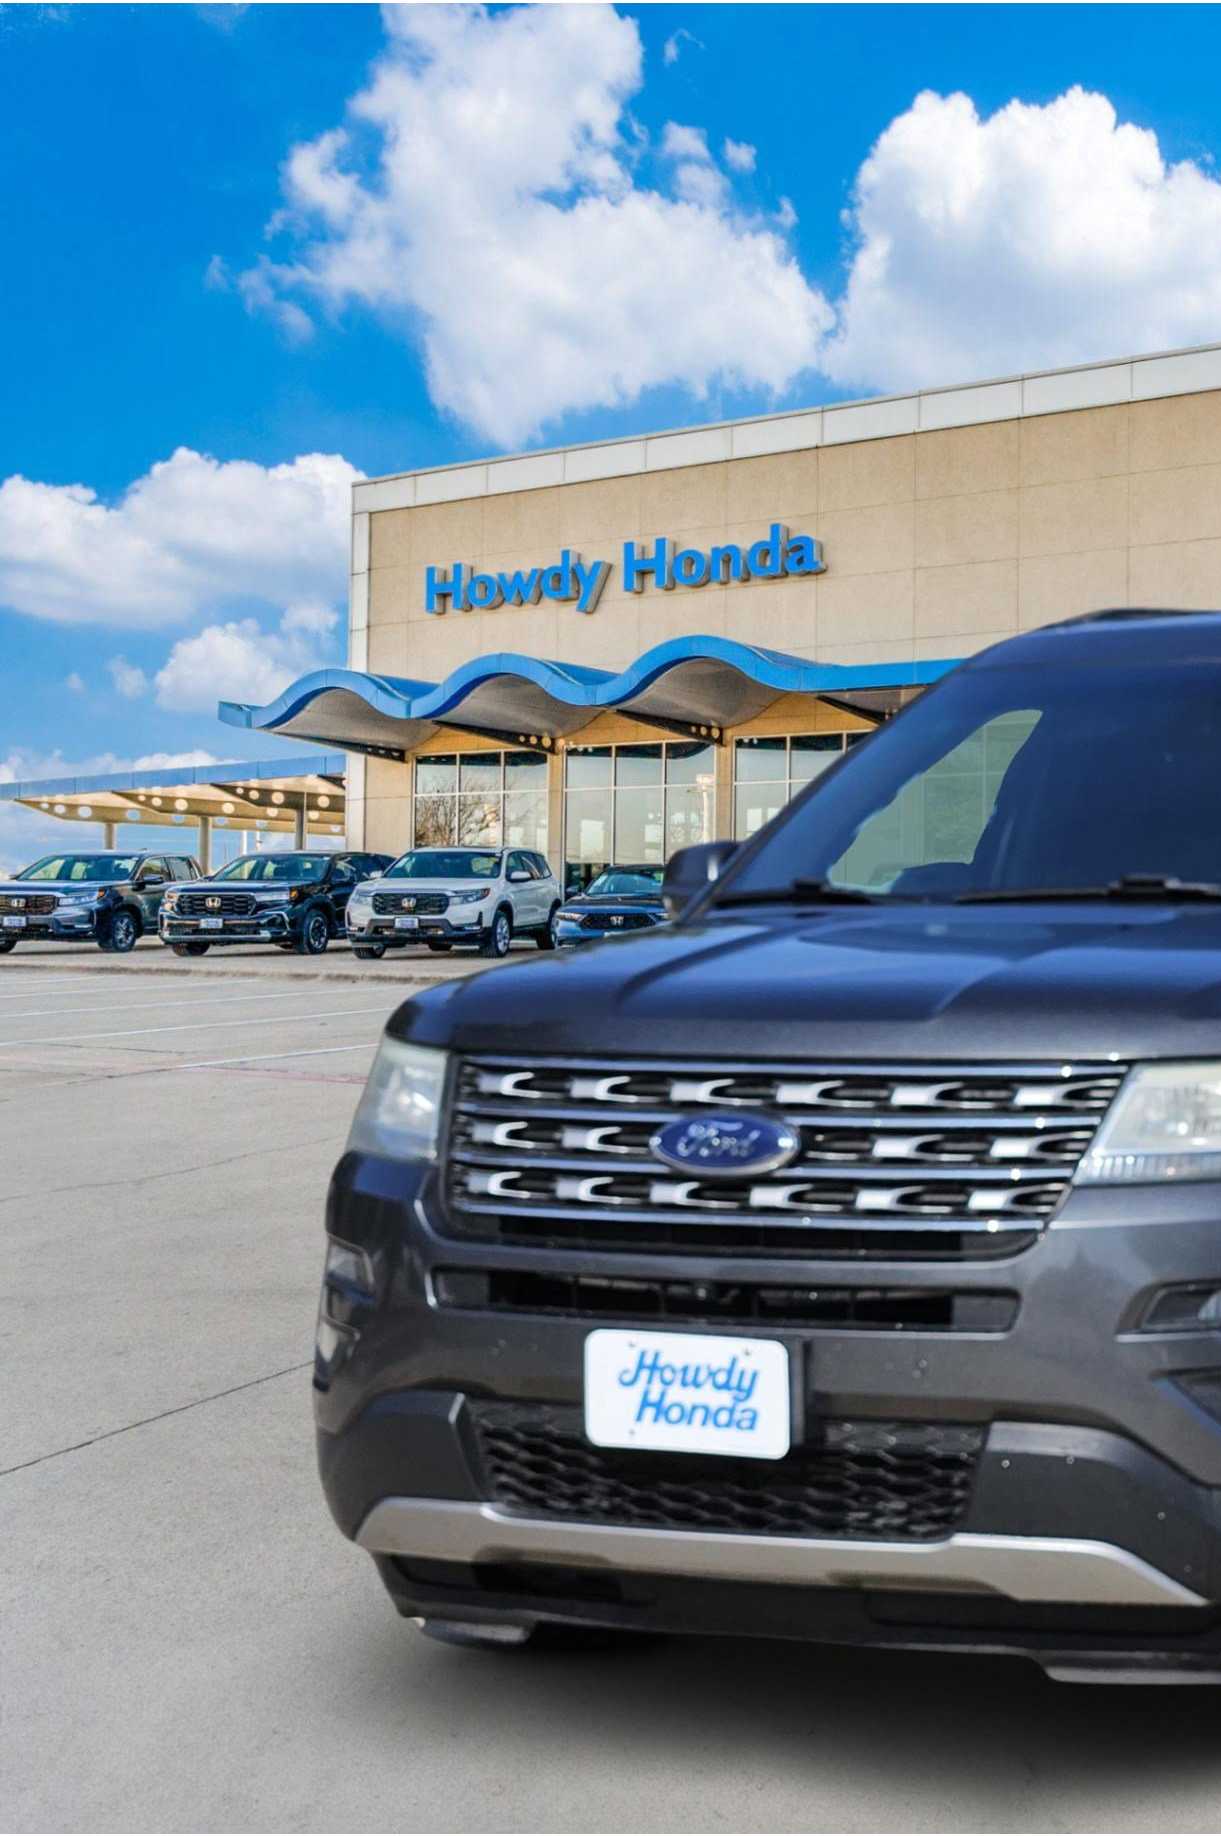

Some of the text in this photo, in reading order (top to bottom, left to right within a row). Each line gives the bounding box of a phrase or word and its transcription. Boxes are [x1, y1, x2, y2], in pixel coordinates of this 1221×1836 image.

[425, 523, 825, 614] Howdy Honda
[618, 1350, 759, 1402] Howdy
[635, 1388, 758, 1431] Honda
